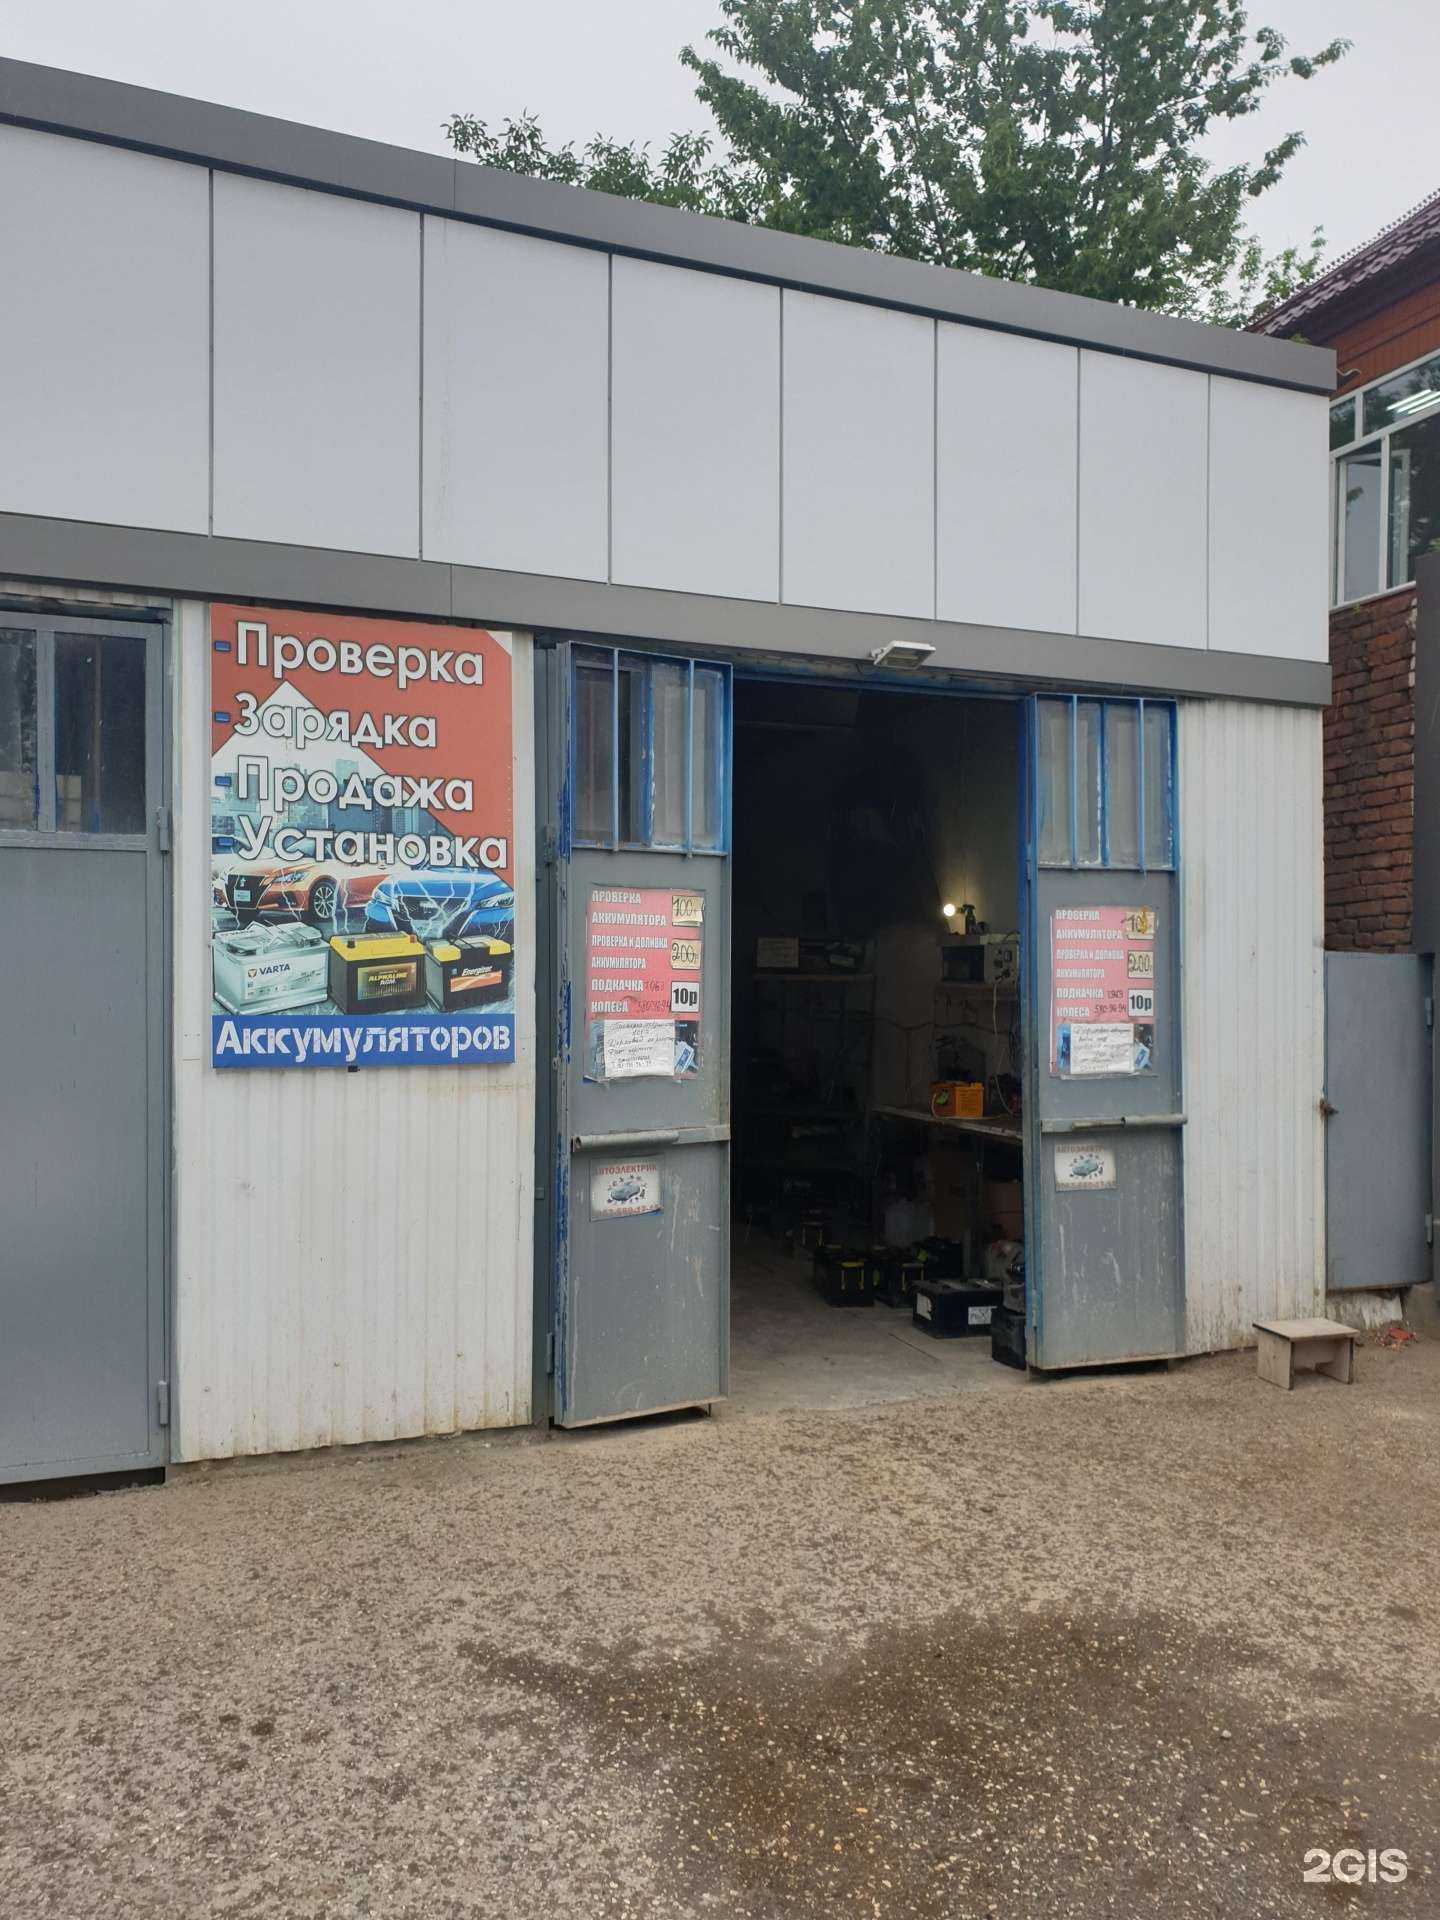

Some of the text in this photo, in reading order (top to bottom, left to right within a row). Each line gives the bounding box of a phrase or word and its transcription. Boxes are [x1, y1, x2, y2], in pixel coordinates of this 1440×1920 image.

[235, 620, 484, 689] Проверка
[233, 691, 438, 750] Зарядка
[237, 754, 474, 813] Продажа
[237, 815, 508, 870] Установка
[592, 890, 641, 905] ПРОВЕРКА
[592, 912, 667, 927] АККУМУЛЯТОРА
[592, 935, 628, 949] ПРОВЕРКА
[259, 963, 291, 976] VARTA
[591, 979, 644, 992] ПОДКАЧКА
[673, 987, 698, 1007] 10р
[1129, 994, 1152, 1012] 10р
[591, 1000, 629, 1013] КОЛЕСА
[215, 1019, 511, 1063] Аккумуляторов
